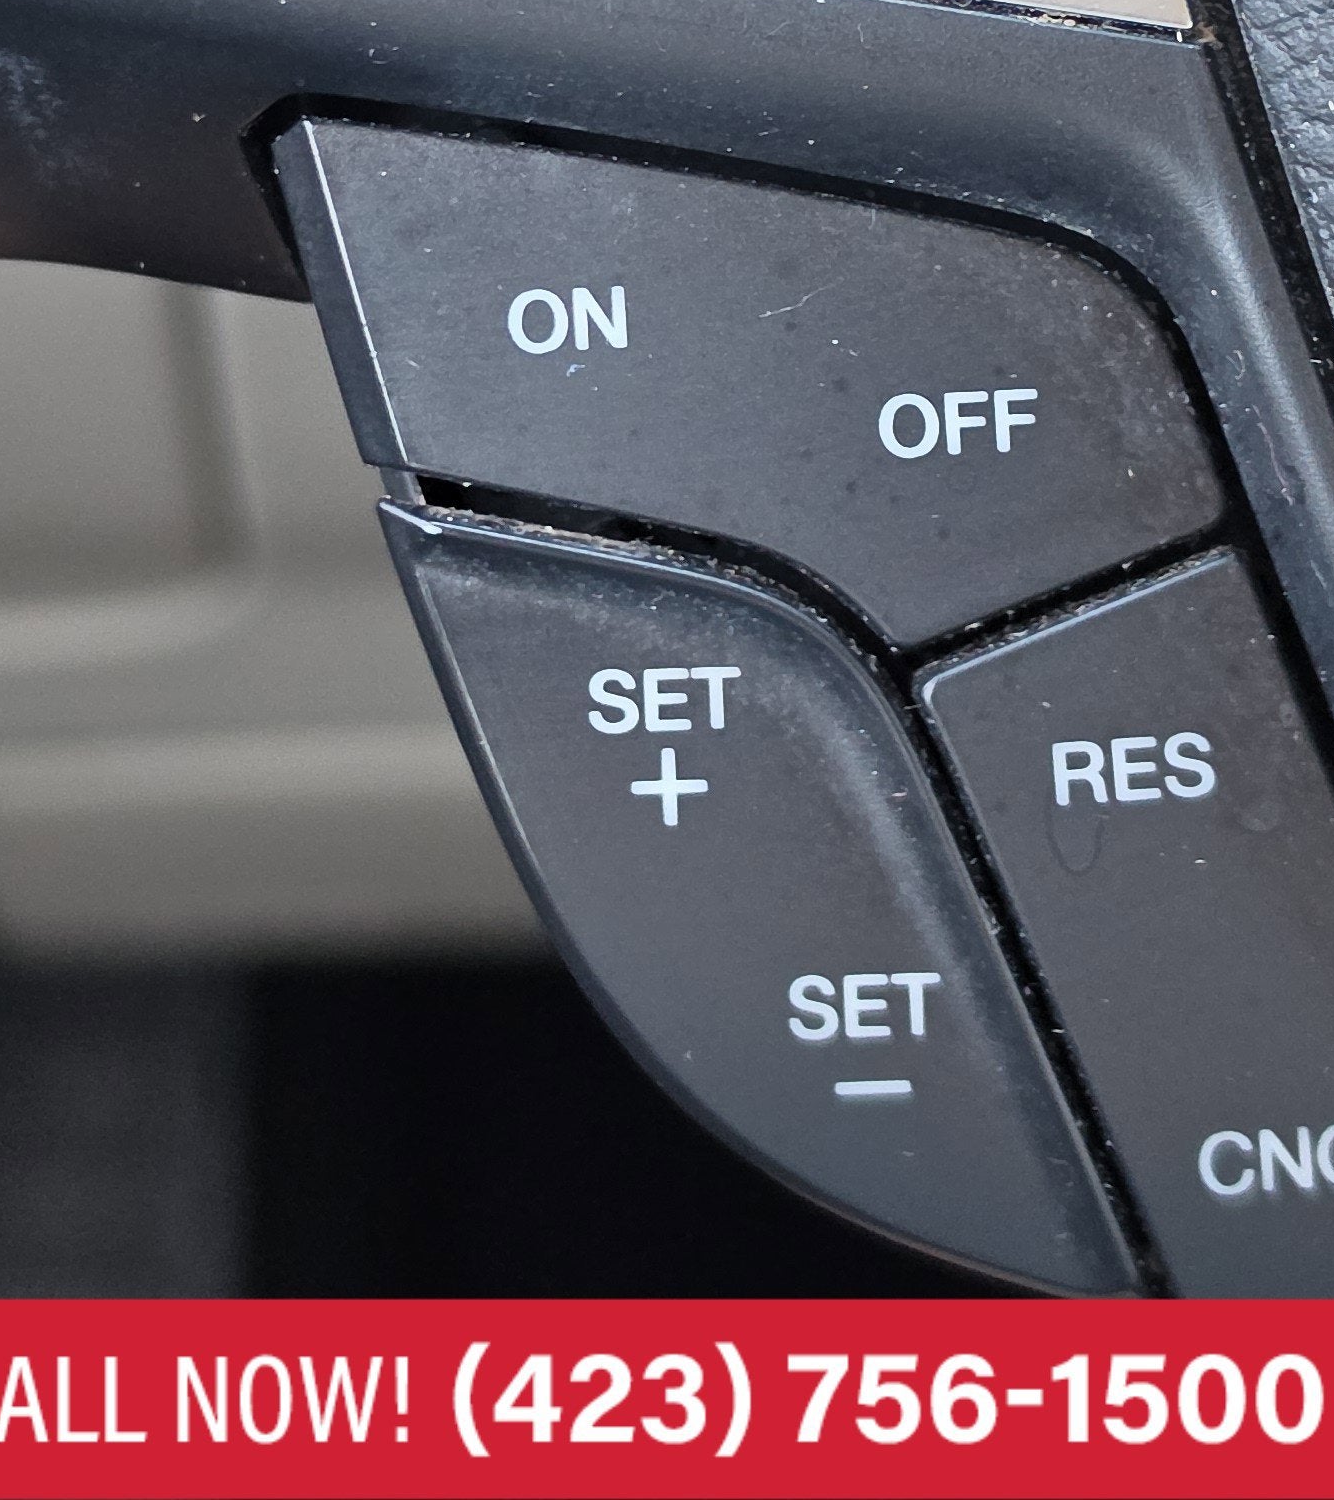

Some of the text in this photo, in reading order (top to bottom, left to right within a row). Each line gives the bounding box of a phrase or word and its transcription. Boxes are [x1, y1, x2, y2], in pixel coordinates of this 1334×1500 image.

[507, 285, 628, 355] ON
[878, 388, 1039, 459] OFF
[587, 666, 742, 735] SET
[1051, 731, 1216, 807] RES
[788, 972, 942, 1041] SET
